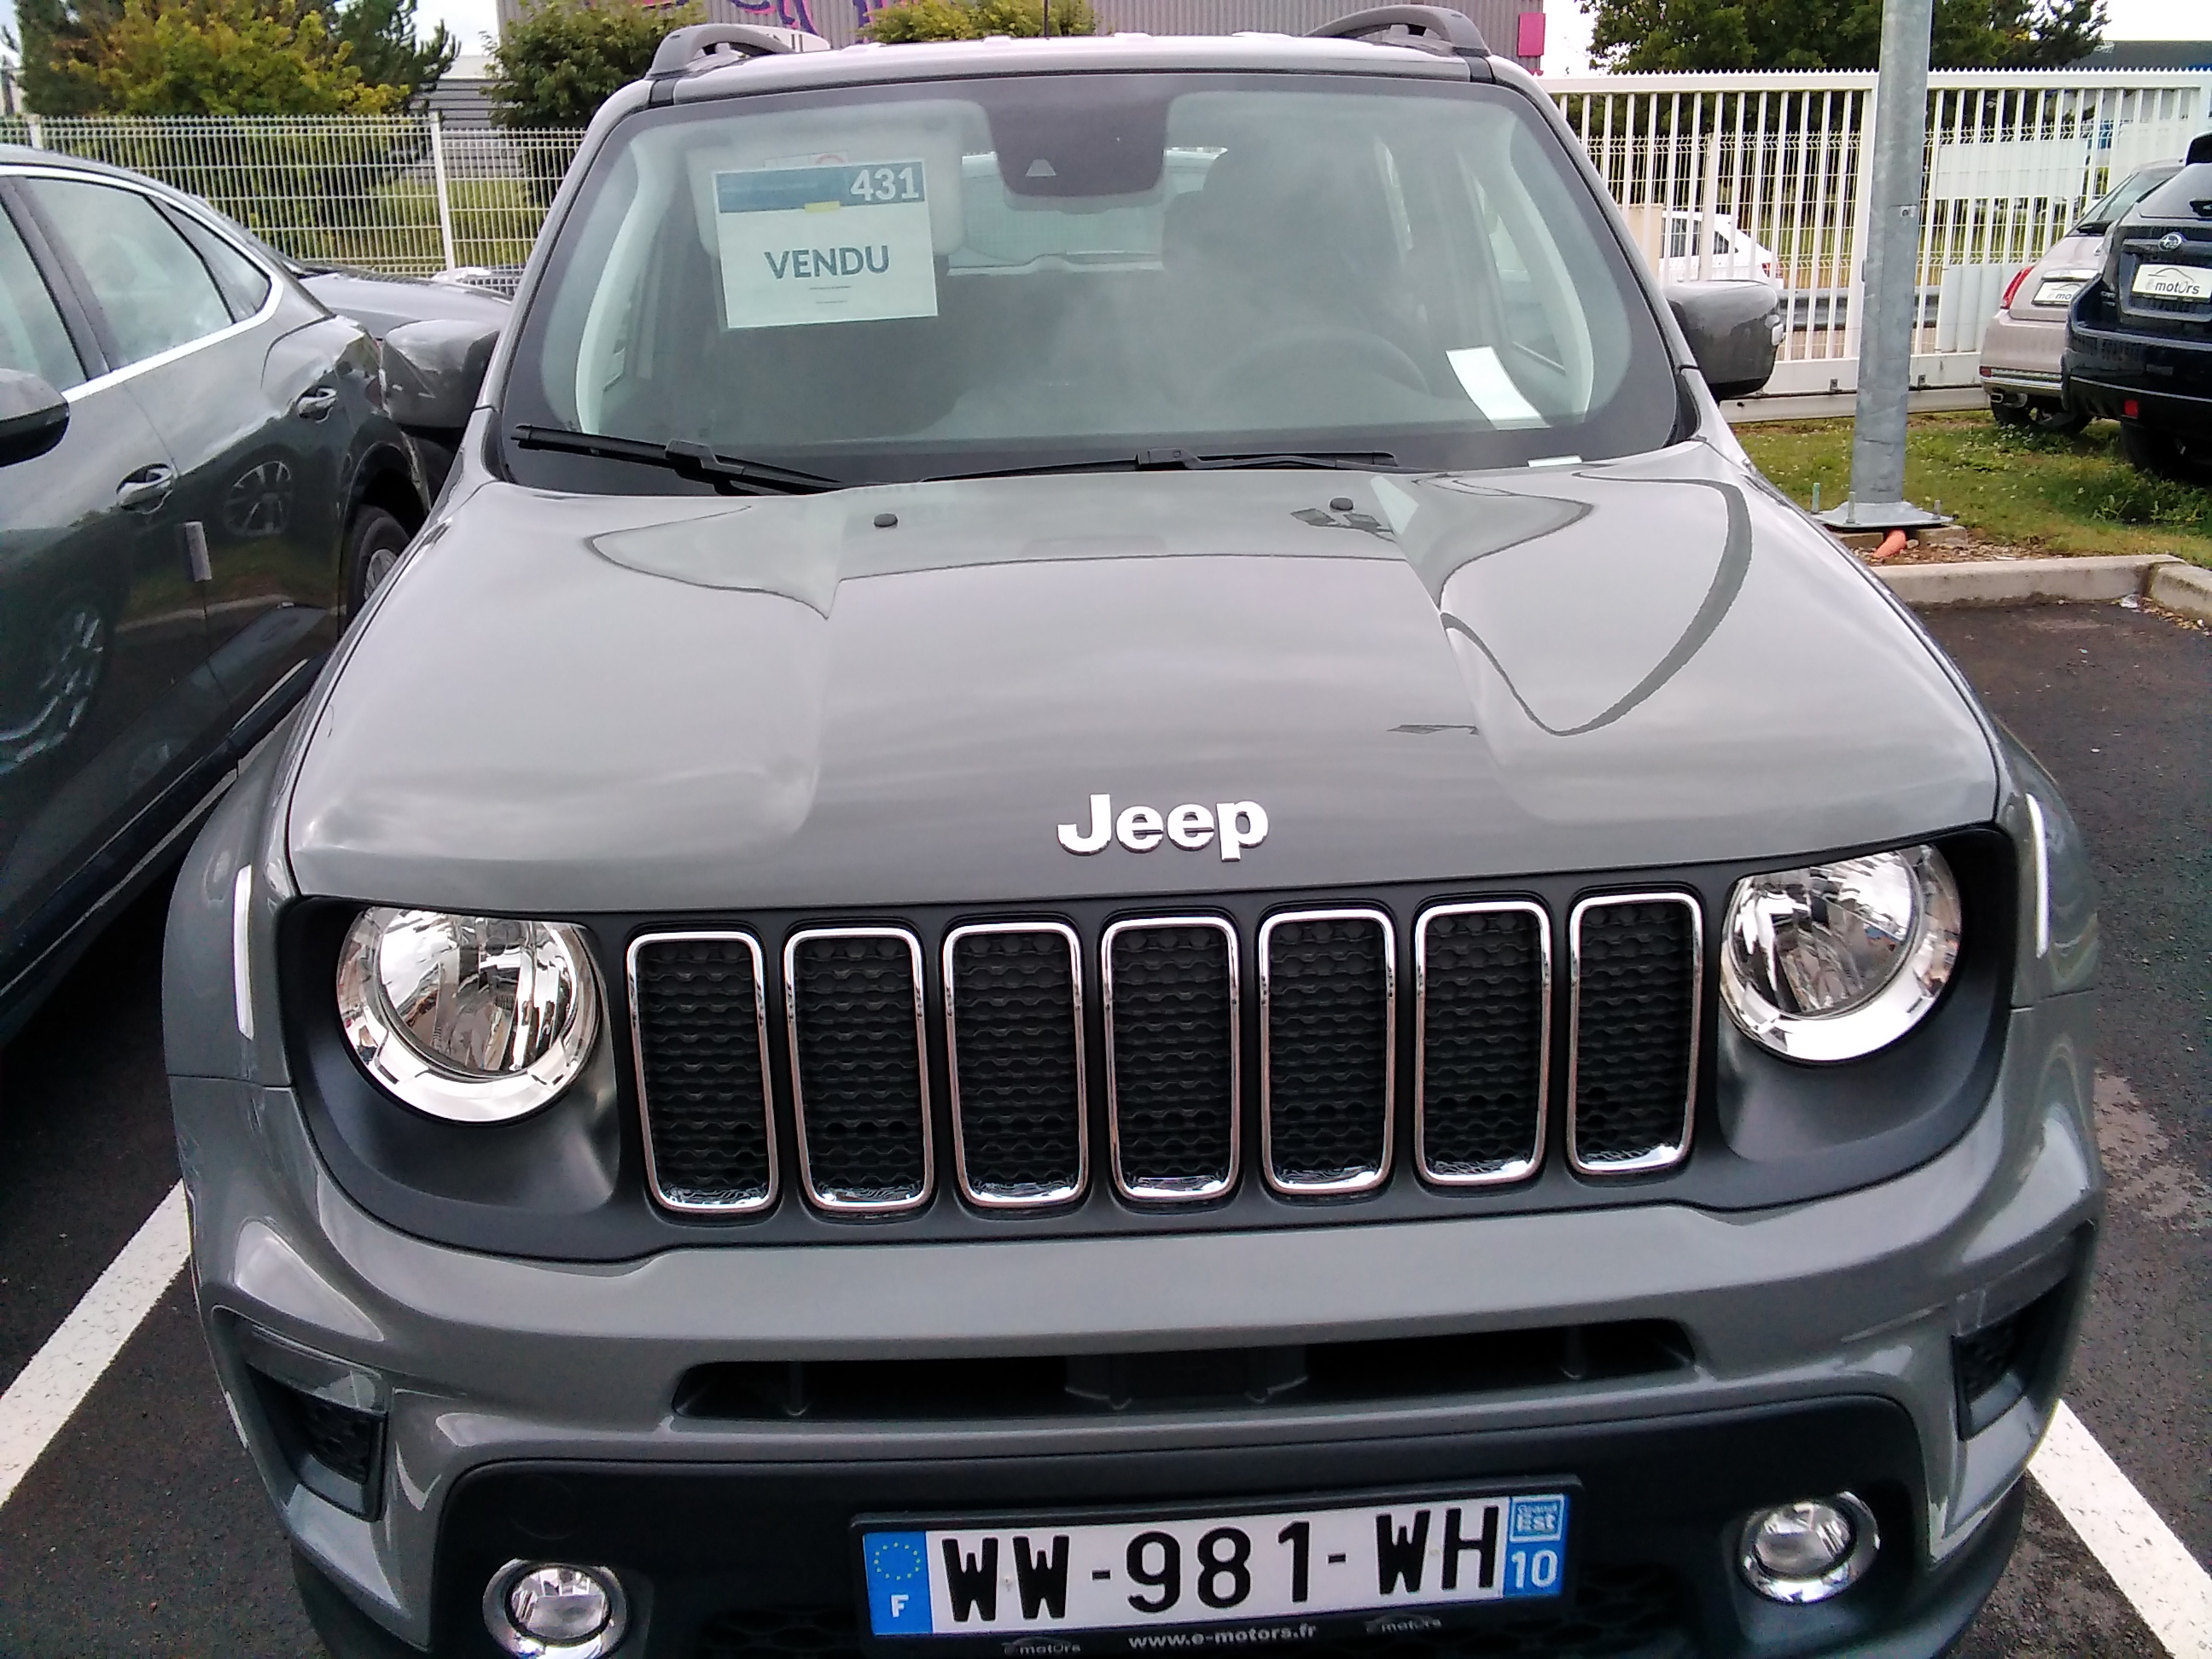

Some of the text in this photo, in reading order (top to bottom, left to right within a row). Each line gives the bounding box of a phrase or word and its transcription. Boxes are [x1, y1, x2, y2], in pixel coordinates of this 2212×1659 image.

[849, 166, 919, 201] 431
[763, 244, 890, 280] VENDU
[1057, 793, 1269, 863] Jeep
[1516, 1514, 1556, 1534] Est
[1511, 1549, 1559, 1589] 10
[890, 1593, 910, 1619] F
[1127, 1622, 1318, 1650] www.e-motors.fr
